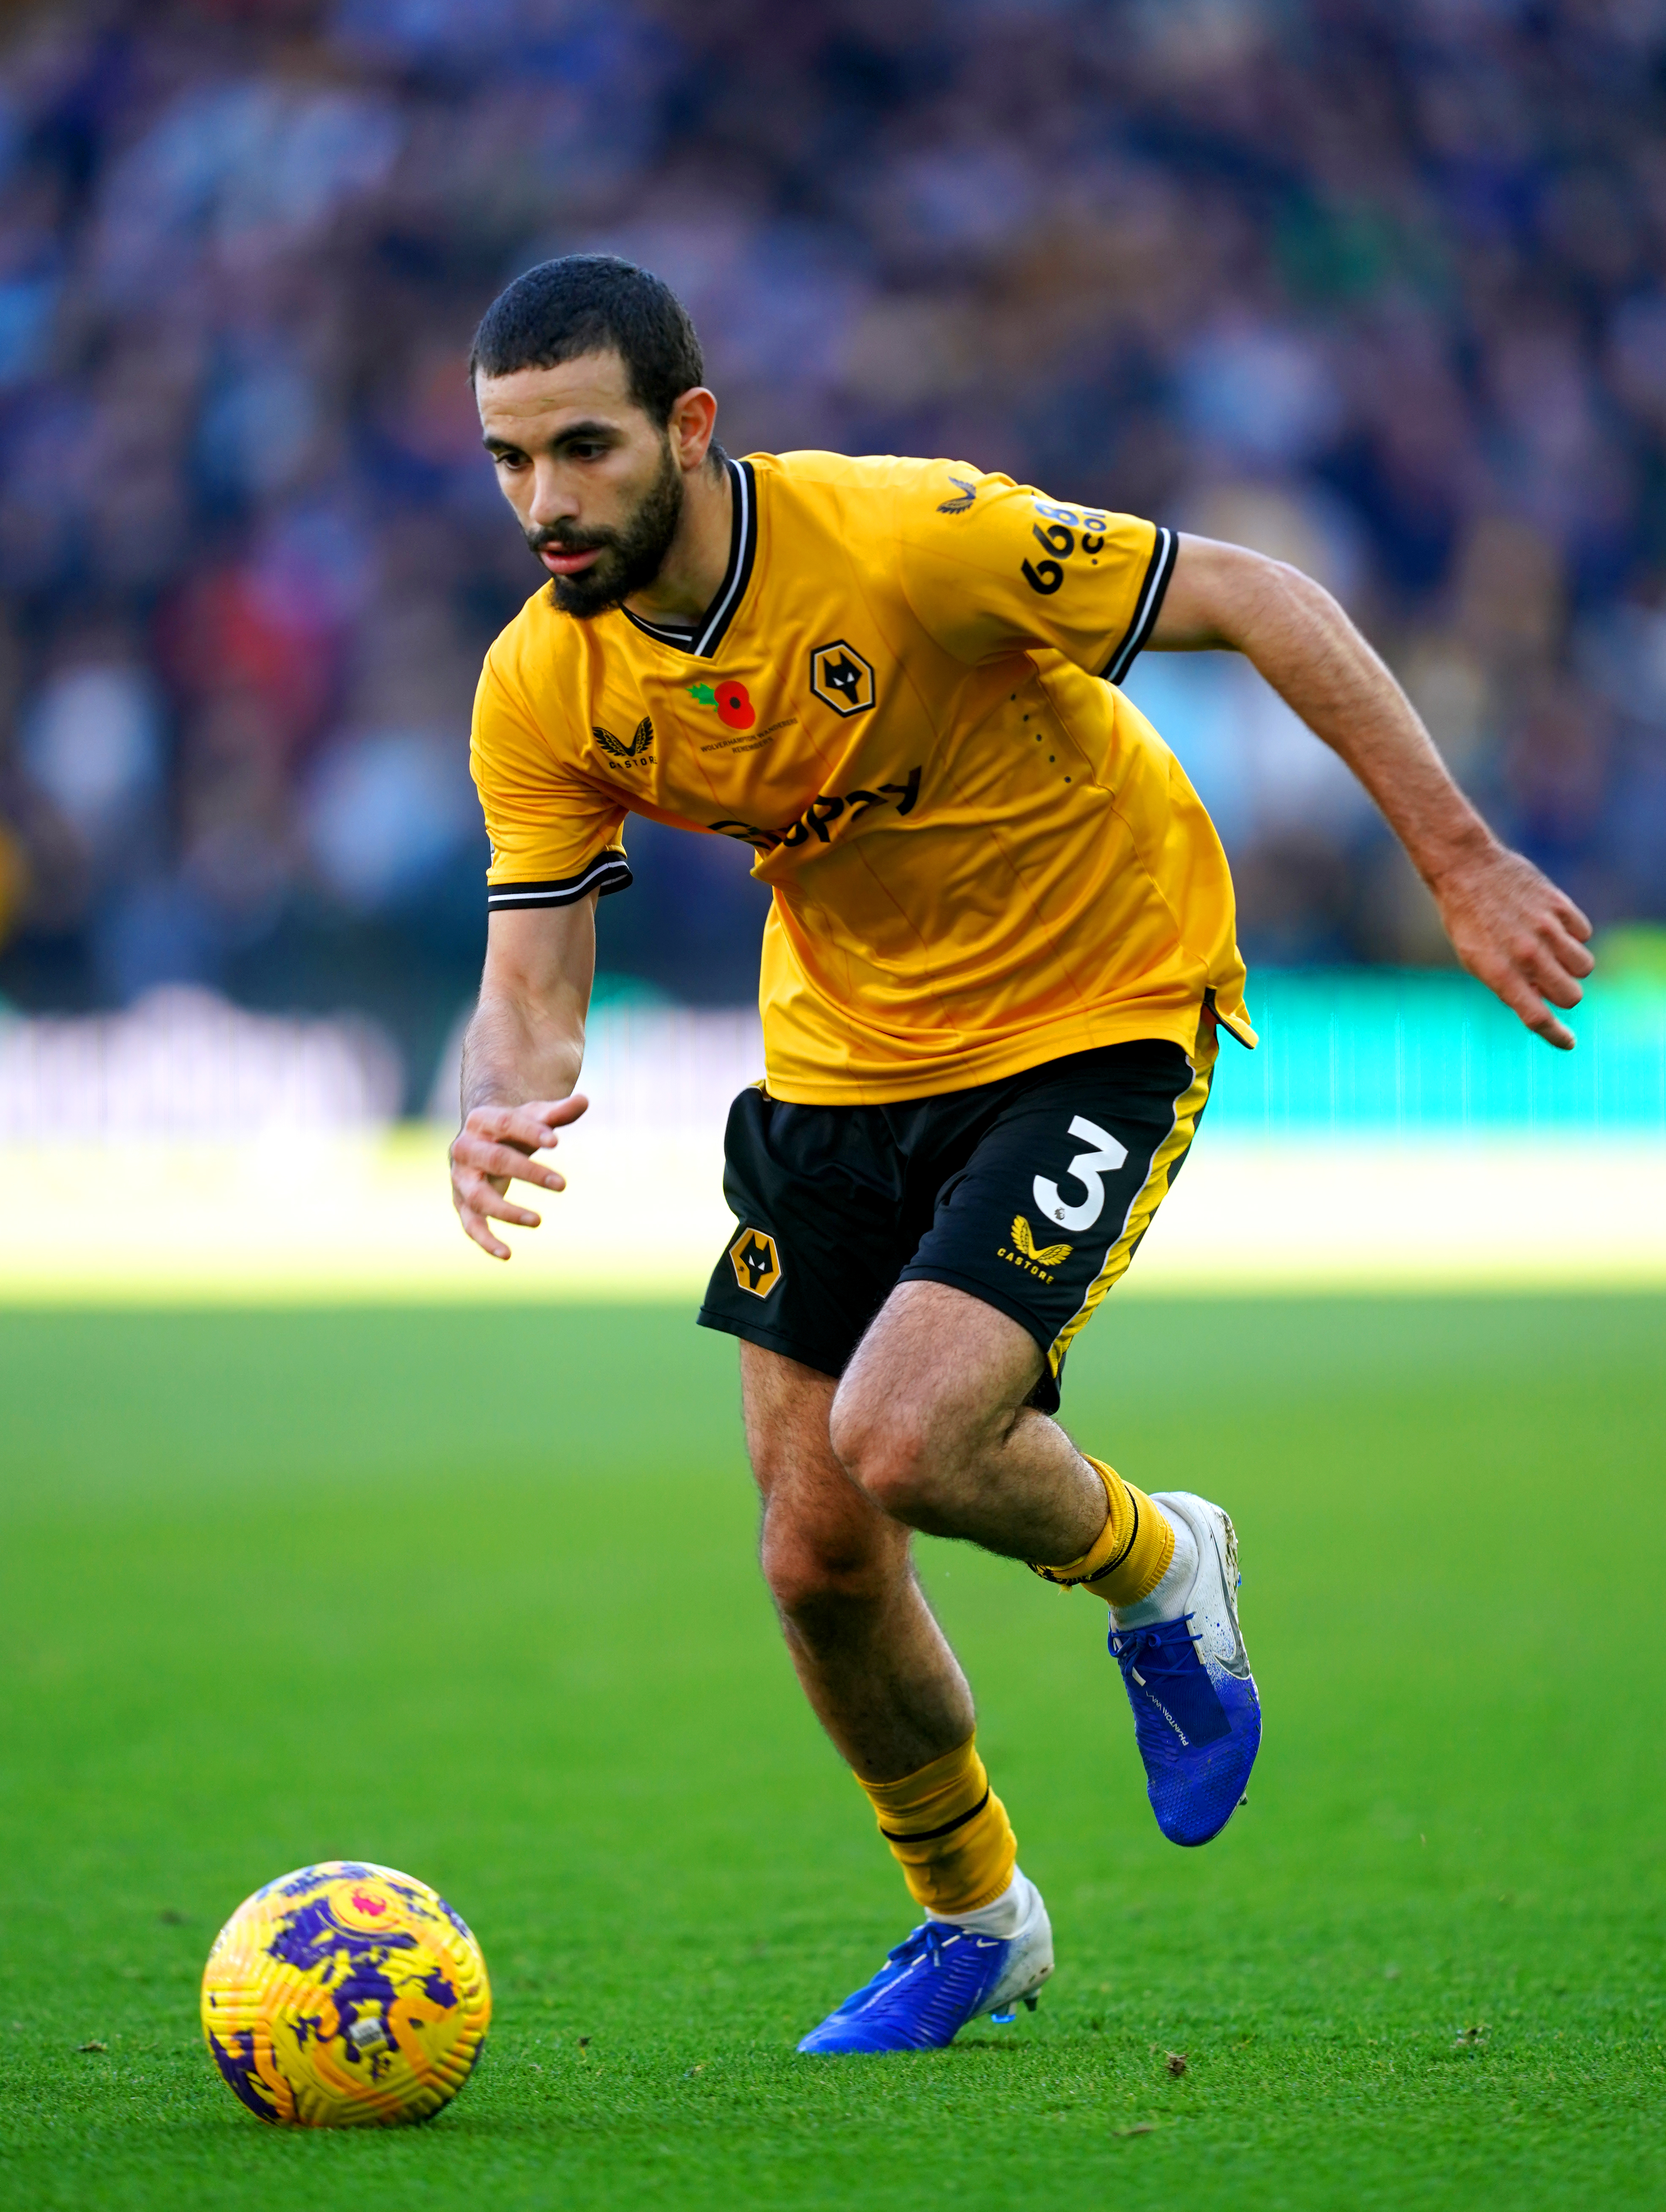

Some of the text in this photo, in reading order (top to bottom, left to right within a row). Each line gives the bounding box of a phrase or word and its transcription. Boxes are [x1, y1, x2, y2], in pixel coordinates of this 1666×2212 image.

[1020, 491, 1079, 595] 668
[1032, 1115, 1129, 1231] 3
[997, 1247, 1054, 1285] CASTORE
[1163, 1706, 1189, 1747] PHANTOM
